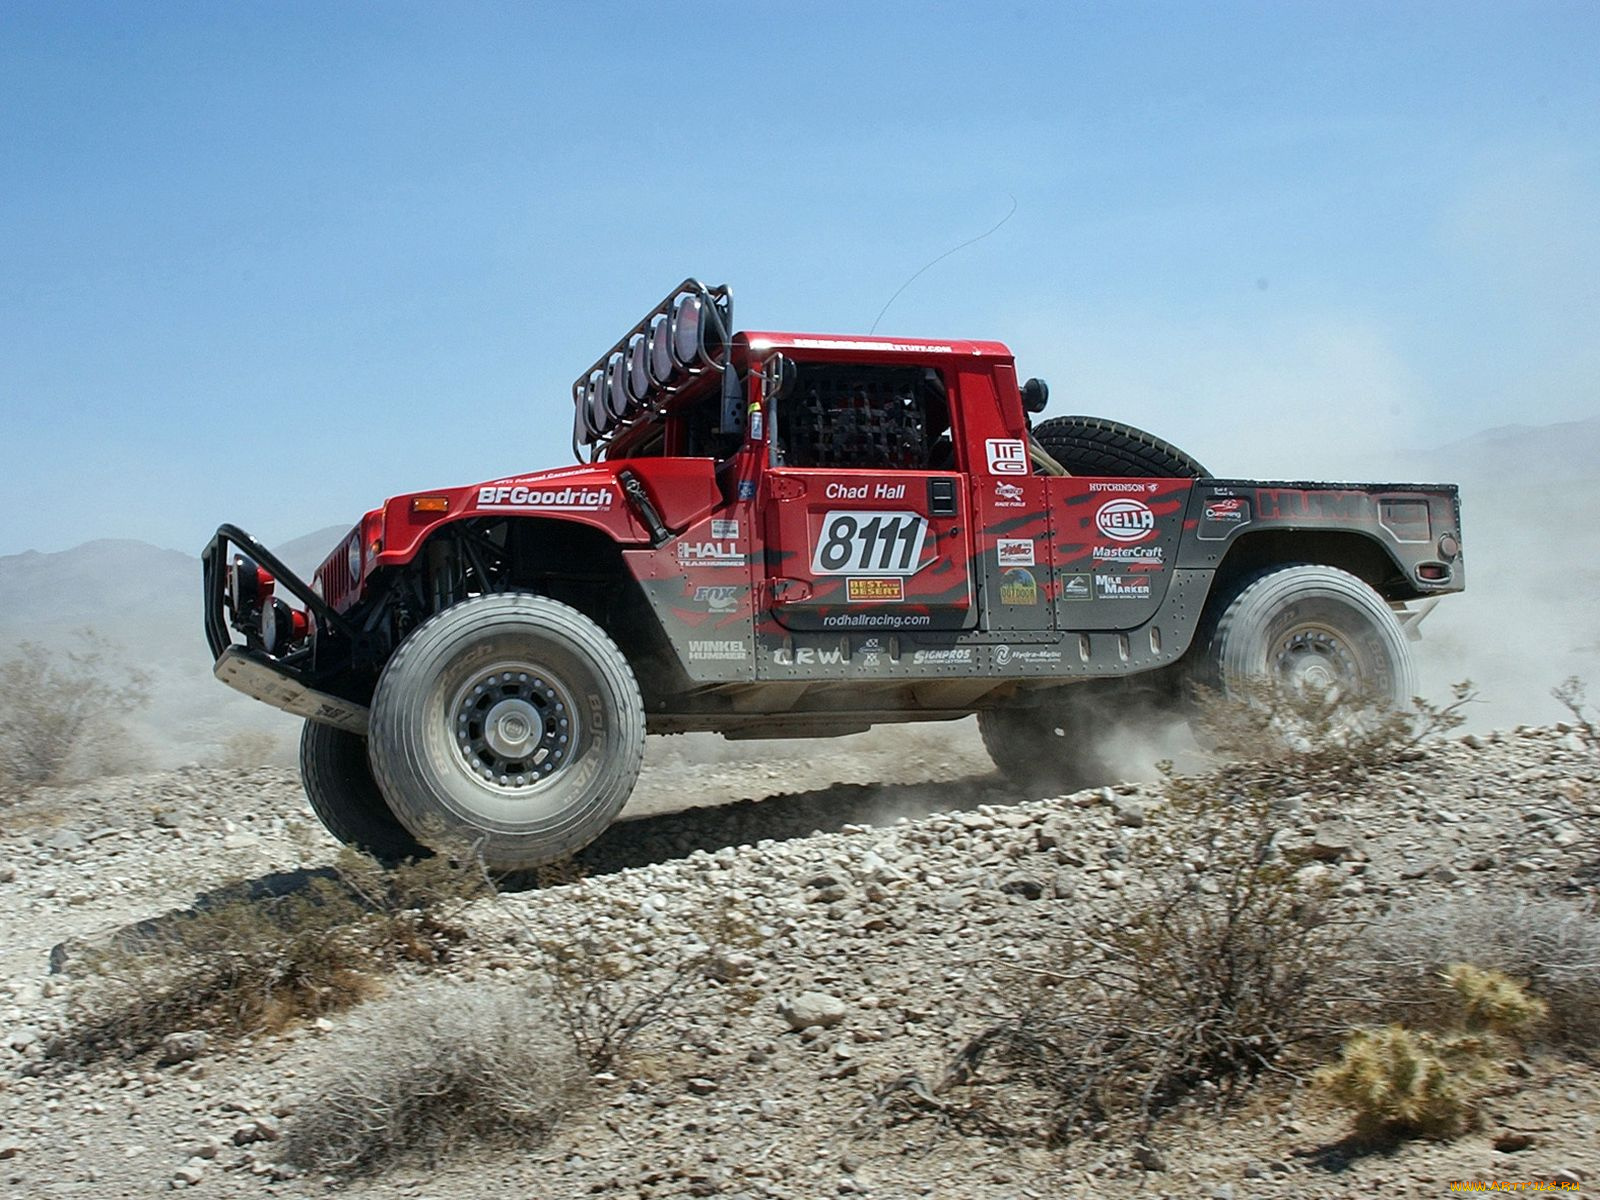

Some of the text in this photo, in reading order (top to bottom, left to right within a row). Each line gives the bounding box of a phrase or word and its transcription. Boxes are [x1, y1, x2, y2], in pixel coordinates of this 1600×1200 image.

[825, 483, 906, 499] Chad Hall
[1089, 483, 1145, 492] HUTCHINSON
[477, 486, 613, 505] BFGoodrich
[1101, 510, 1154, 529] HELLA
[820, 516, 922, 570] 8111
[683, 542, 745, 558] HALL
[1093, 546, 1162, 558] MasterCraft
[850, 580, 883, 588] BEST
[1104, 584, 1149, 594] MARKER
[694, 587, 737, 601] FOX
[823, 614, 930, 627] rodhallracing.com
[688, 641, 746, 652] WINKEL
